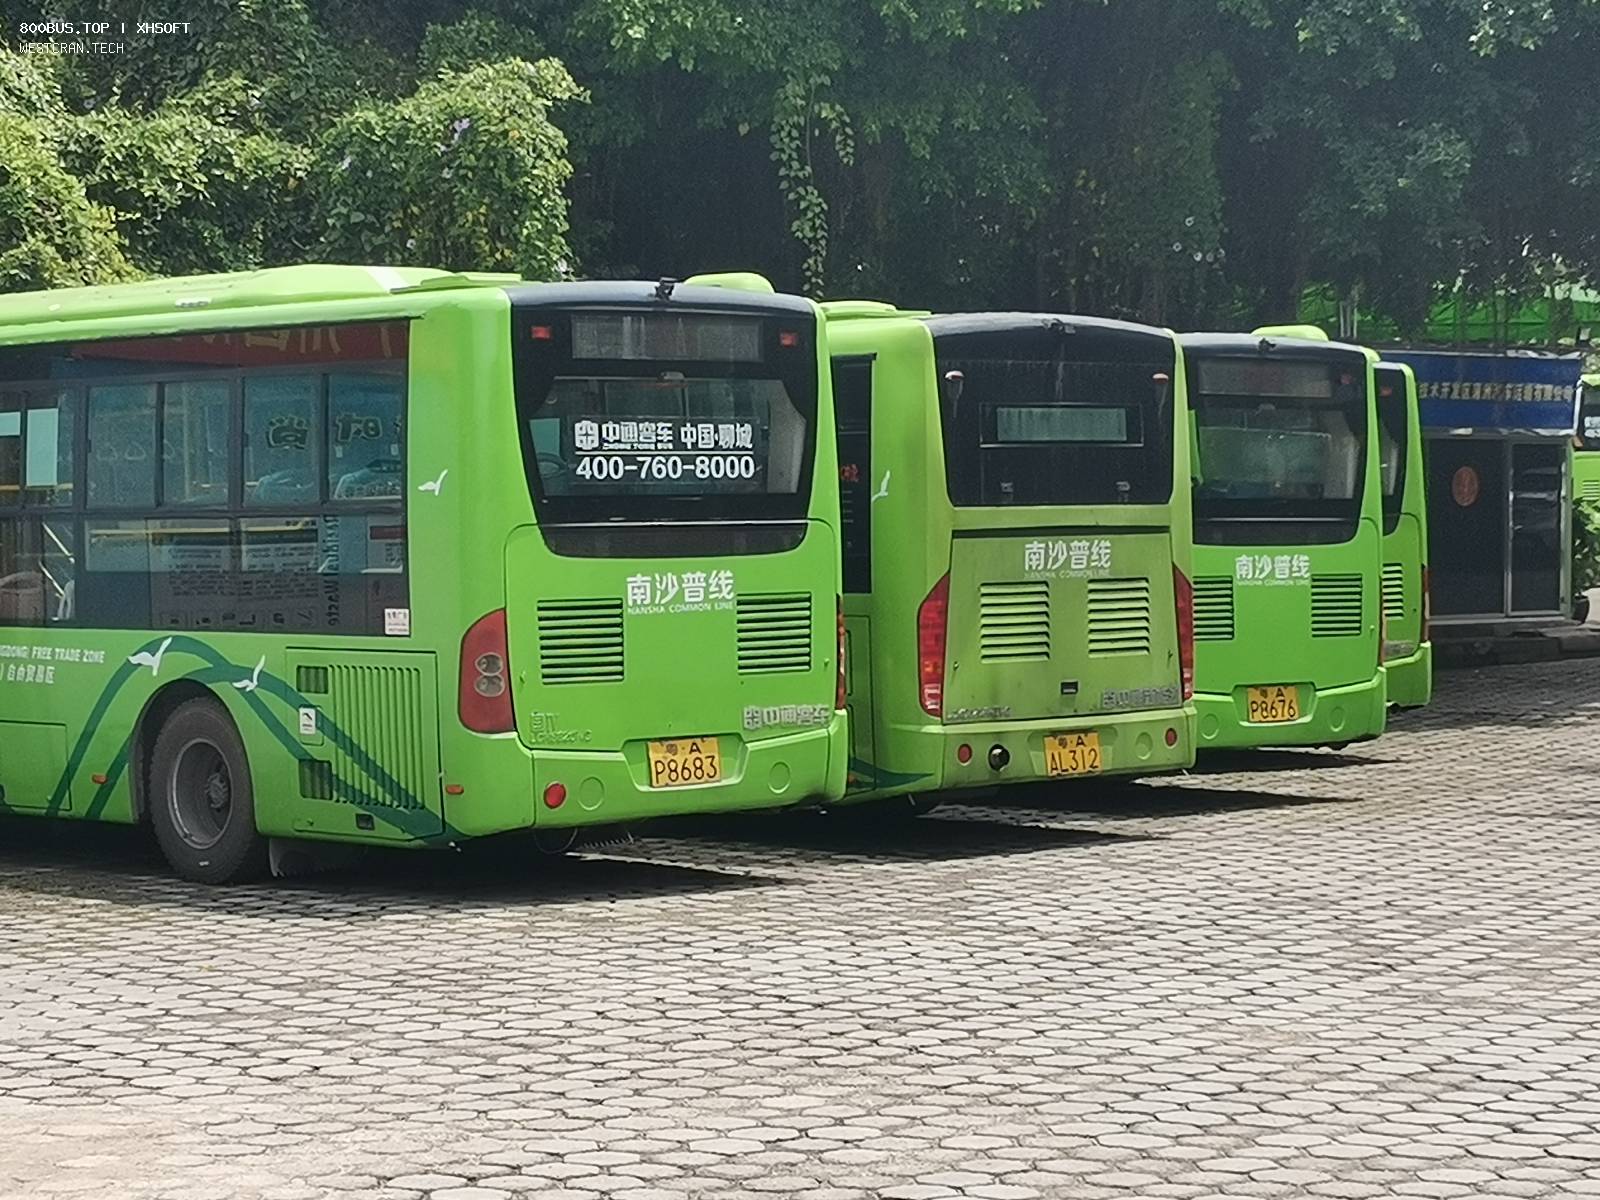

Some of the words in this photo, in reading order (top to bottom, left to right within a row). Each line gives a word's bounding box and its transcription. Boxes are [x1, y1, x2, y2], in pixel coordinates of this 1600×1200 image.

[602, 421, 673, 443] 中通客车
[575, 455, 755, 480] 400-760-8000
[1024, 539, 1112, 571] 南沙普线
[1235, 554, 1311, 579] 南沙普线
[626, 570, 734, 607] 南沙普线
[32, 646, 53, 659] FREE
[55, 648, 81, 662] TRADE
[83, 649, 105, 663] ZONE
[1250, 699, 1296, 719] P8676
[654, 755, 718, 784] P8683
[1050, 748, 1099, 774] AL312
